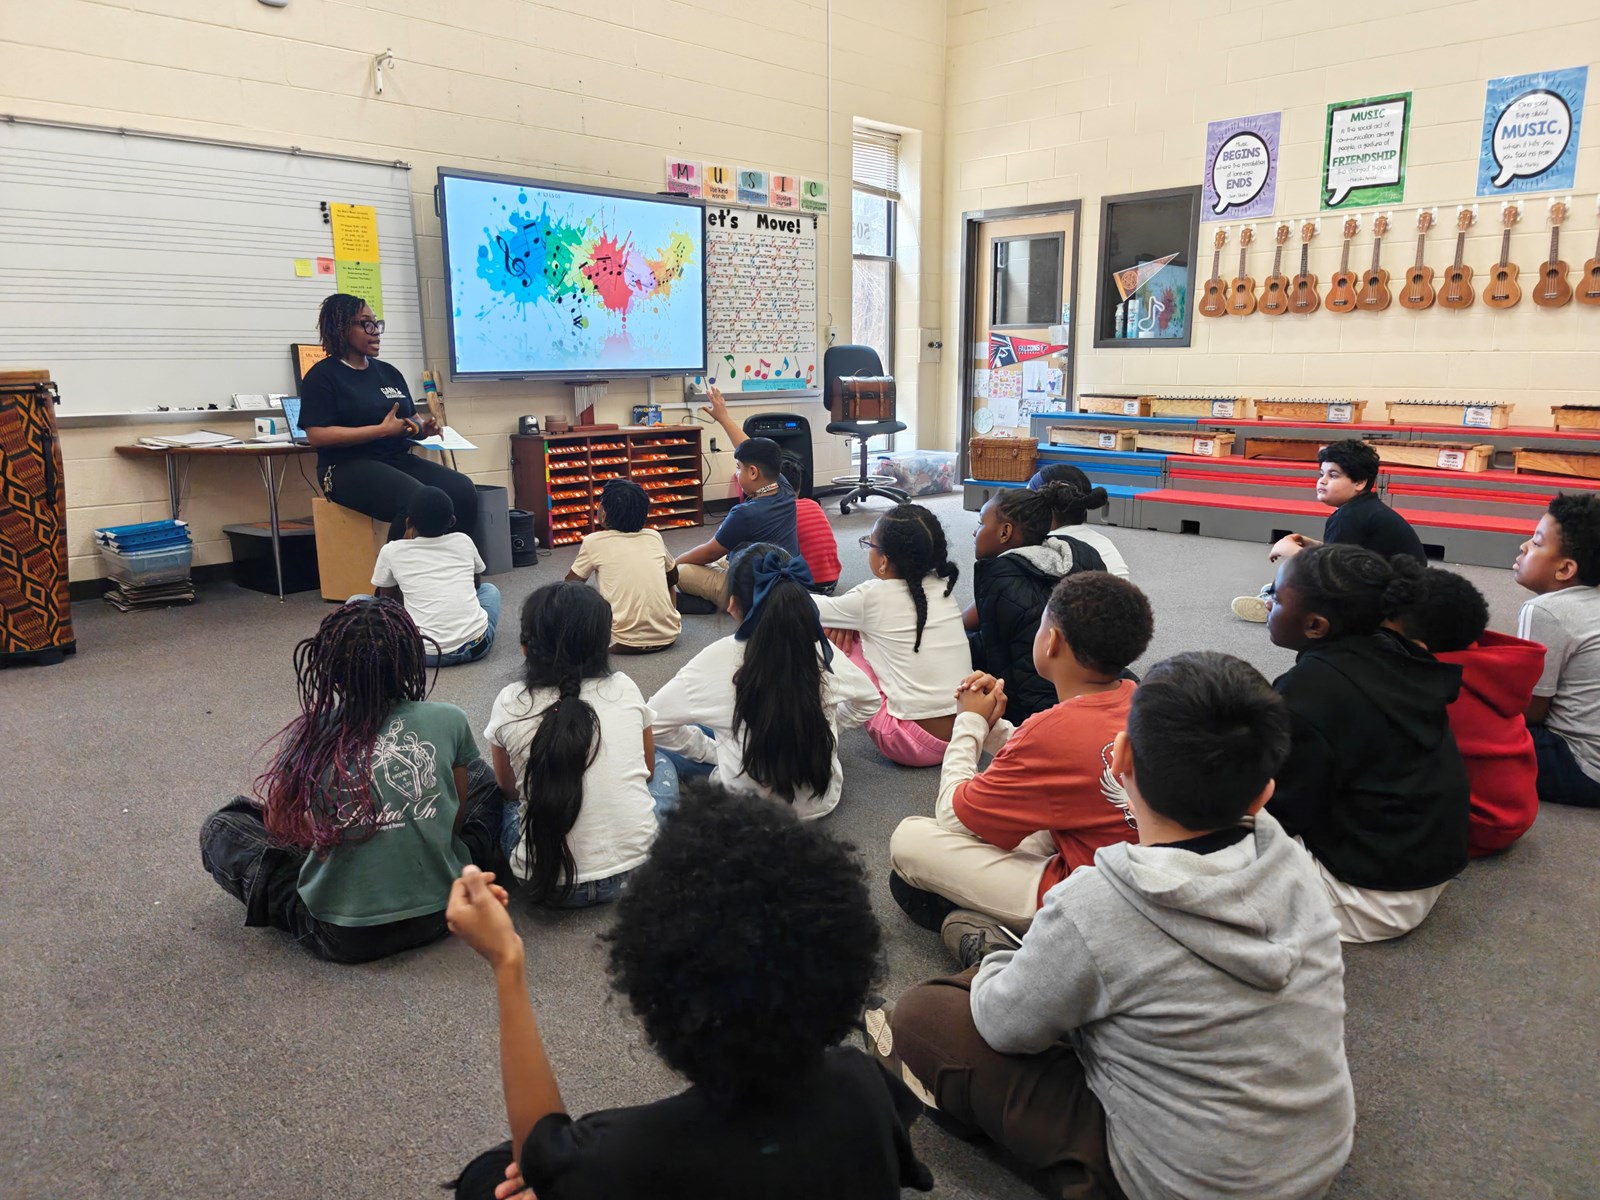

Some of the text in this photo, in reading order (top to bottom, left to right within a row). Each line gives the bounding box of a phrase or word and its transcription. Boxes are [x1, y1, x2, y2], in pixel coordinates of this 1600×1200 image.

[1350, 108, 1386, 123] MUSIC
[1357, 123, 1373, 131] social
[1373, 121, 1383, 129] act
[1336, 133, 1374, 143] communication
[1222, 147, 1261, 162] BEGINS
[1332, 150, 1397, 167] FRIENDSHIP
[677, 163, 689, 181] M
[714, 167, 723, 184] U
[748, 172, 756, 189] S
[780, 176, 787, 193] I
[1226, 177, 1252, 190] ENDS
[809, 182, 817, 197] C
[708, 209, 801, 234] et's Move!
[1017, 344, 1041, 352] FALCONS
[392, 769, 411, 780] FRIENDS
[402, 781, 413, 789] LIFE
[413, 792, 441, 820] In
